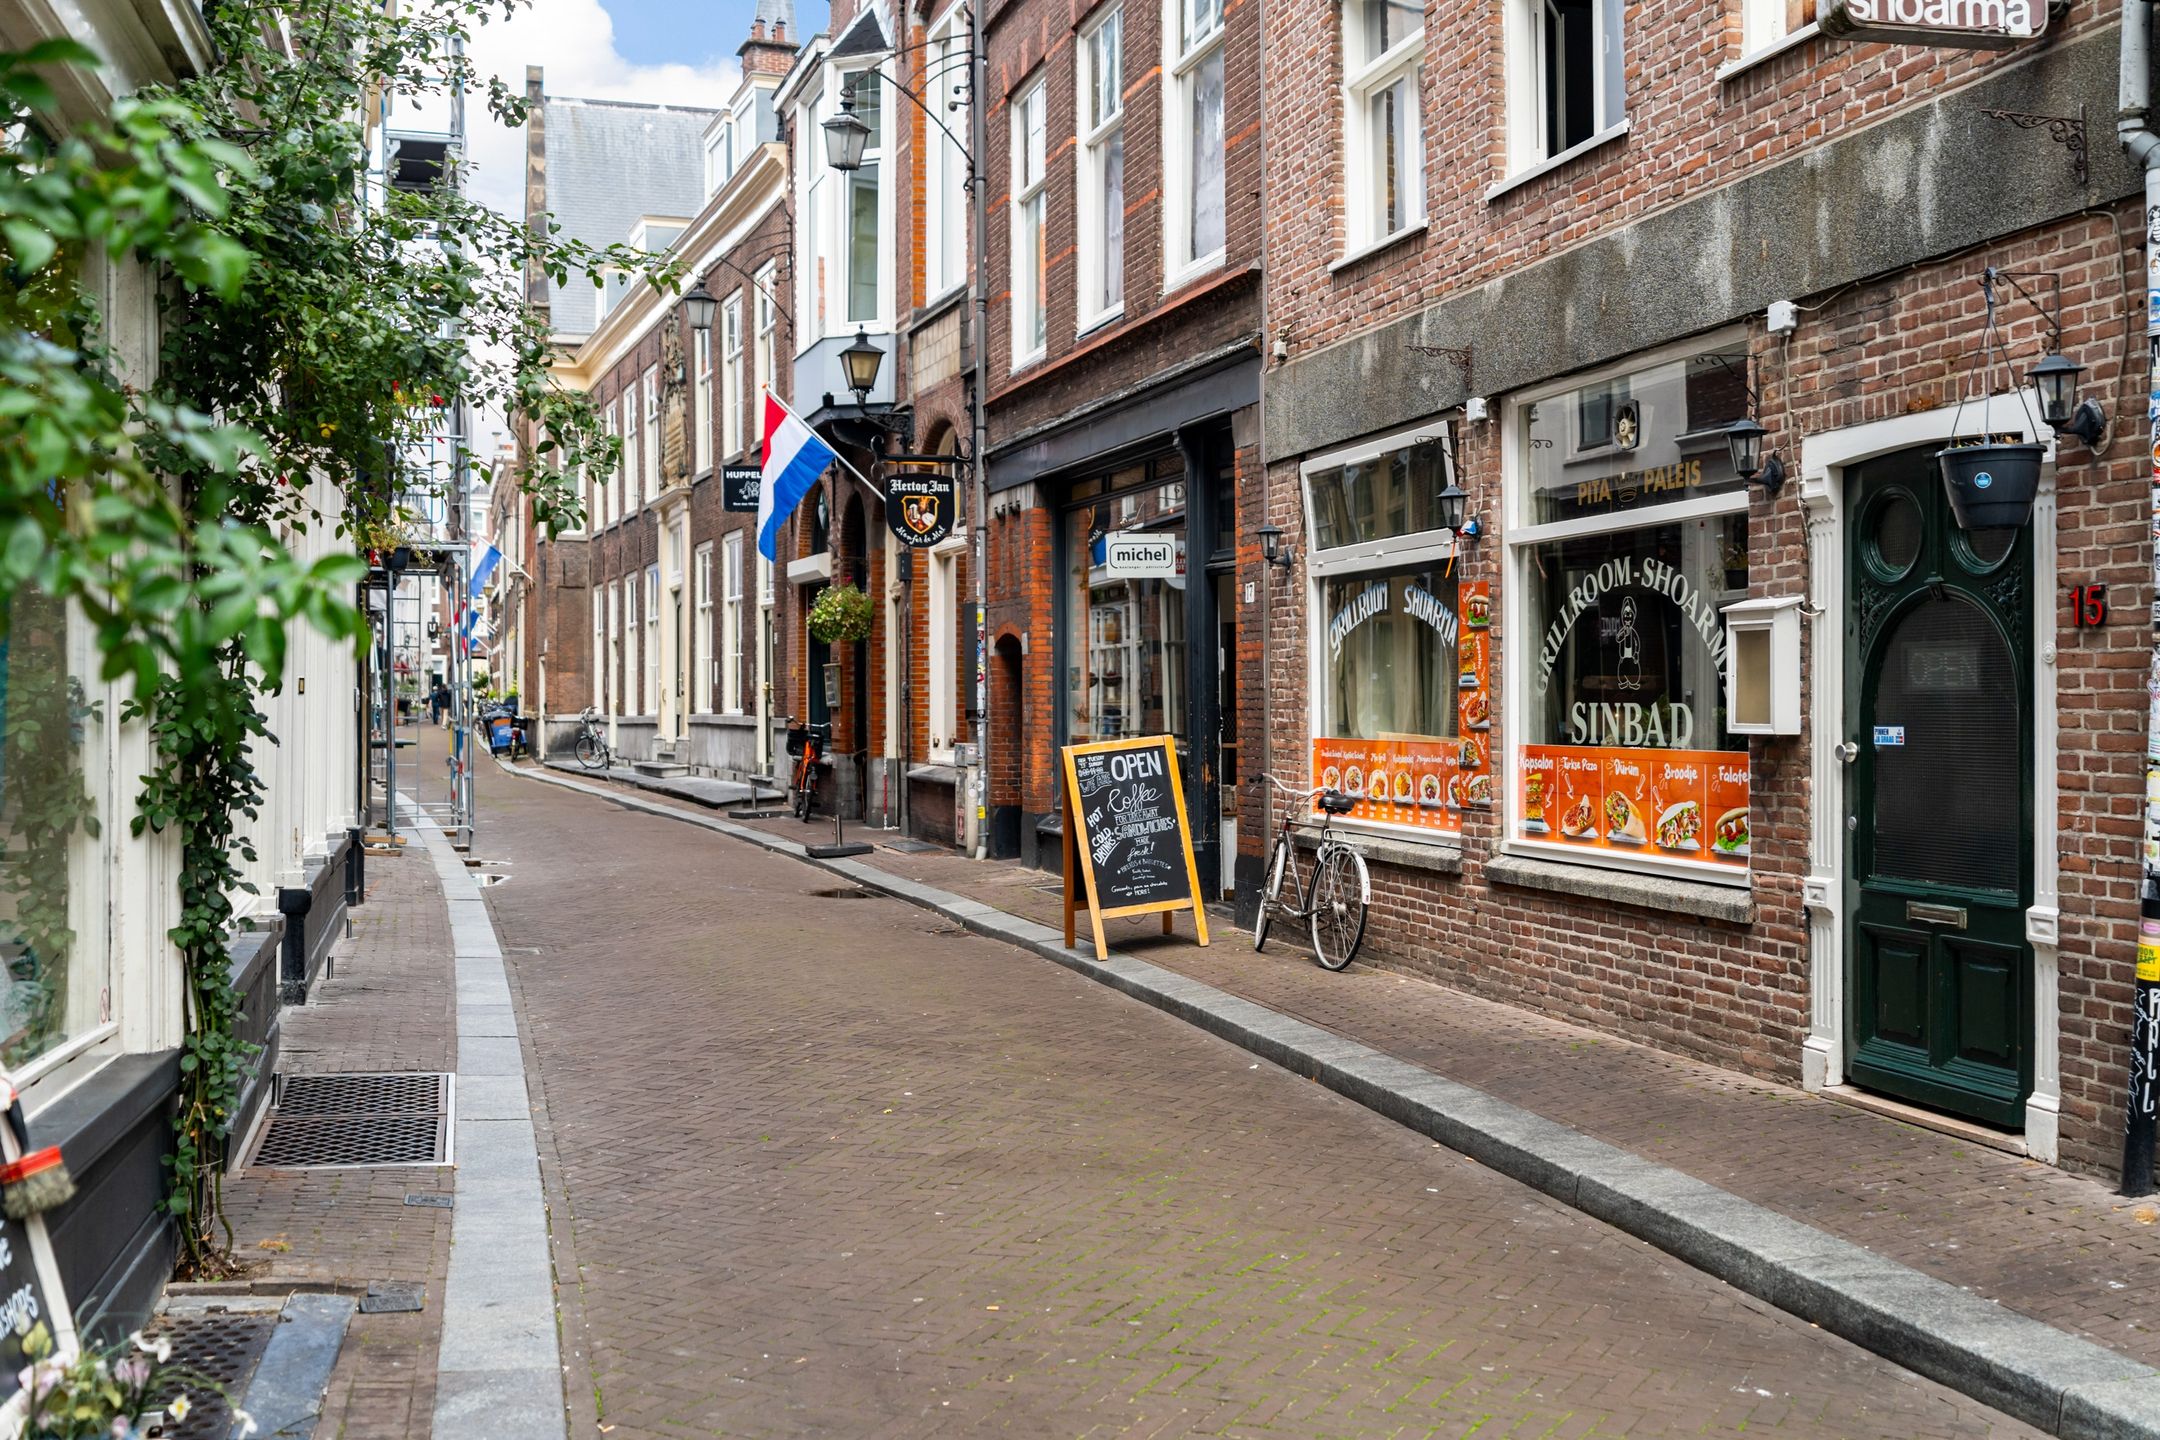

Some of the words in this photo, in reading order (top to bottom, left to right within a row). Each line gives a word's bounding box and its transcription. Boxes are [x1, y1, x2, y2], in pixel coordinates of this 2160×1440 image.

[1848, 0, 2032, 36] shoarma
[890, 479, 928, 494] Hertog
[928, 480, 950, 495] Jan
[1578, 478, 1612, 506] PITA
[1644, 459, 1702, 493] PALEIS
[1117, 547, 1166, 561] michel
[1404, 584, 1459, 648] SHOARMA
[2069, 584, 2106, 627] 15
[1536, 555, 1729, 697] GRILLROOM-SHOARM
[1571, 702, 1694, 748] SINBAD
[1110, 750, 1163, 782] OPEN
[1519, 754, 1554, 770] Kapsalon
[1562, 756, 1581, 770] Turkse
[1582, 757, 1598, 771] Pizza
[1614, 759, 1640, 776] Dürüm
[1663, 763, 1698, 780] Broodje
[1718, 765, 1749, 786] Falafe
[1106, 782, 1163, 815] Coffee
[1086, 806, 1104, 828] HOT
[1115, 814, 1127, 825] FOR
[1092, 836, 1117, 864] DRINKS
